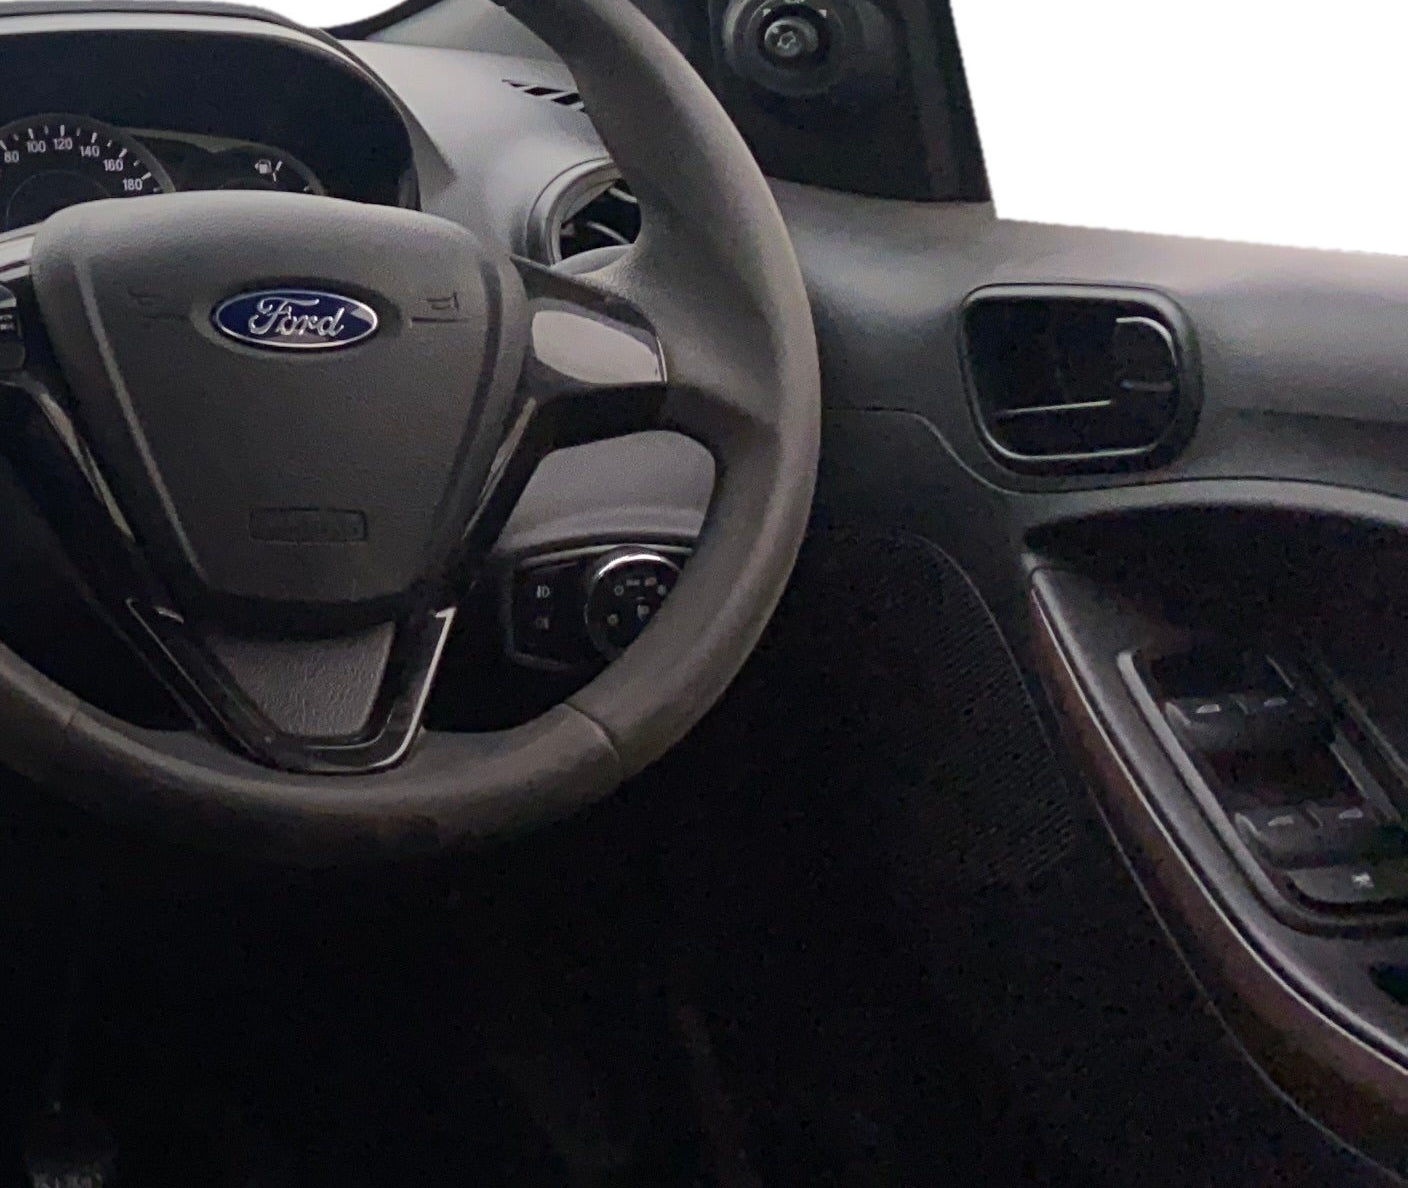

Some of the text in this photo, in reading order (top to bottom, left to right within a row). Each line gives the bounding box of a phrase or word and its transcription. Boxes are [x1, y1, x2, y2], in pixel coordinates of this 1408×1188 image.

[26, 140, 46, 153] 100
[53, 137, 73, 150] 120
[4, 151, 19, 163] 80
[80, 145, 100, 157] 140
[103, 159, 123, 171] 160
[123, 178, 142, 191] 180
[247, 296, 346, 339] Ford
